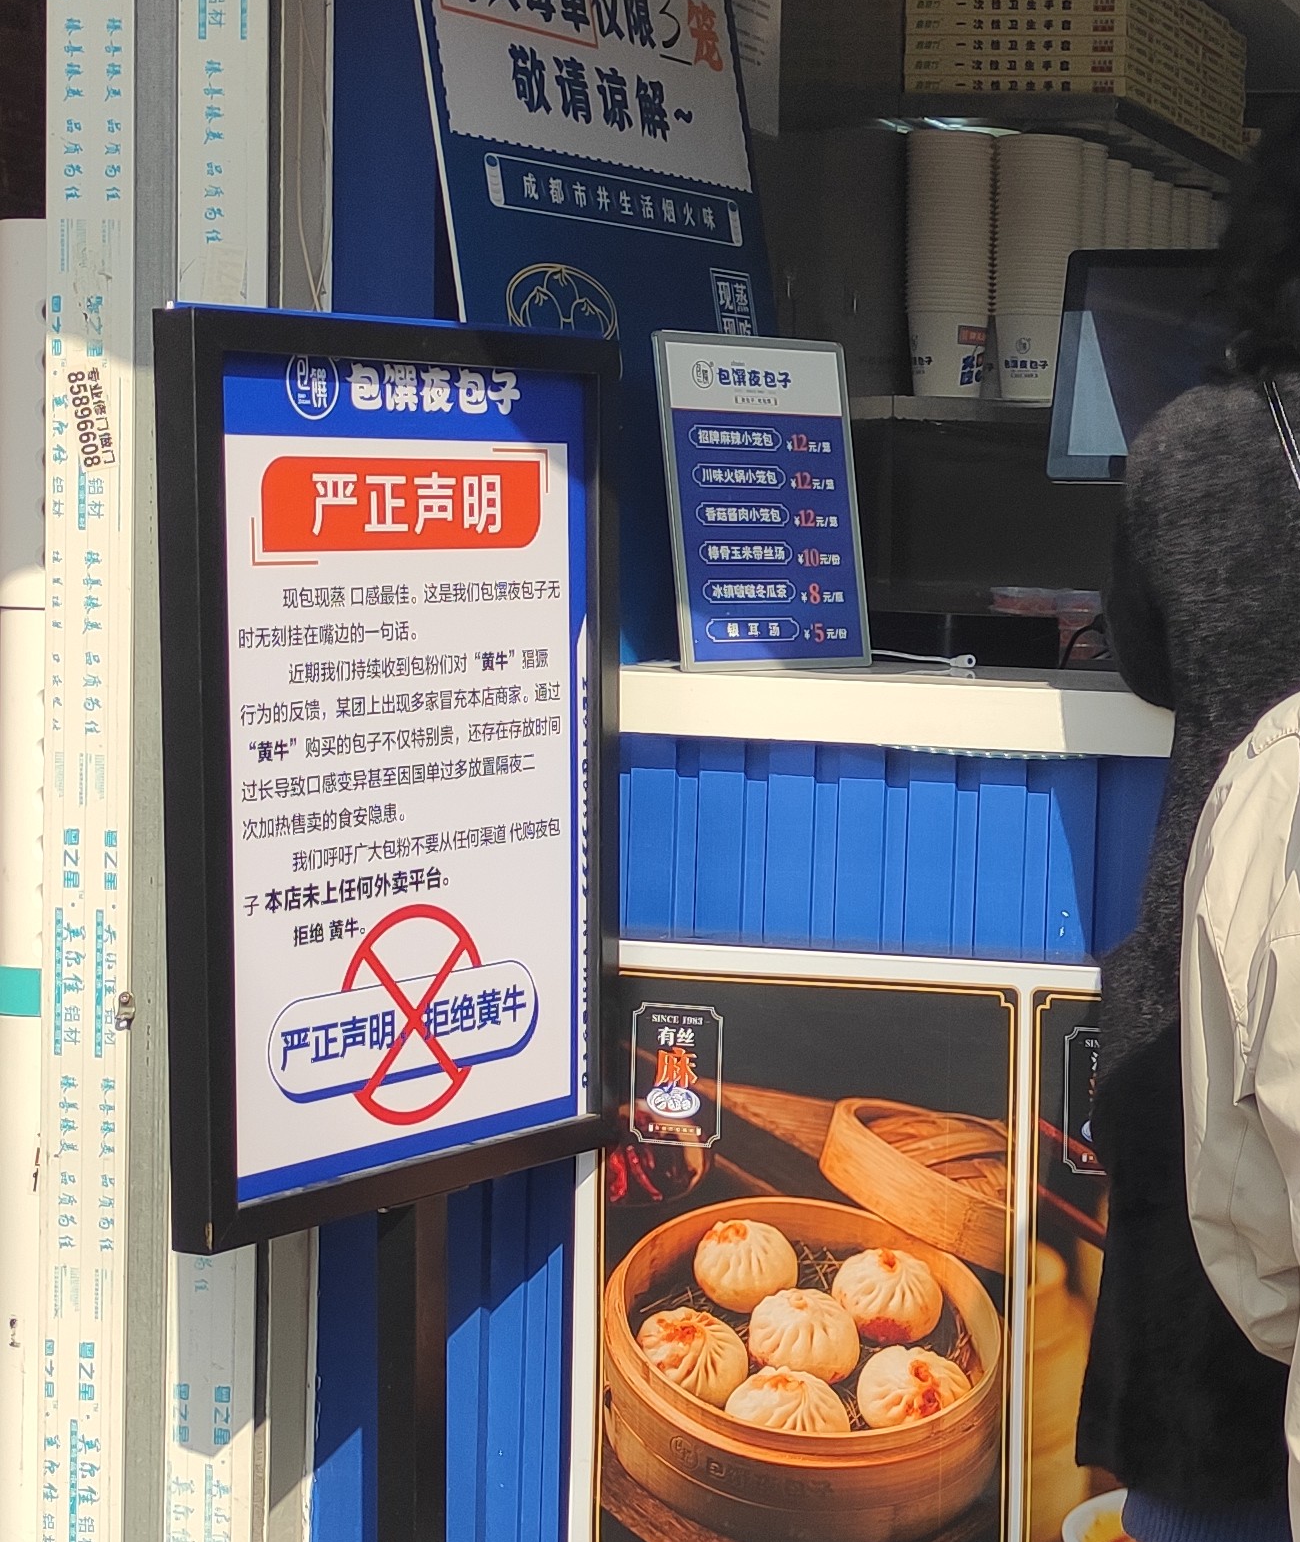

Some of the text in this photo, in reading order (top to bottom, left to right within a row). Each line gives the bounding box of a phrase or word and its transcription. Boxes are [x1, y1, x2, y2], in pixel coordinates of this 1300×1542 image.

[716, 367, 792, 388] 包馔夜包子
[346, 362, 521, 416] 包馔夜包子
[67, 371, 102, 468] 85896608
[698, 429, 774, 447] 招牌麻辣小笼包
[702, 468, 778, 485] 川味火锅小笼包
[311, 471, 503, 536] 严正声明
[238, 621, 418, 649] 时无刻挂在嘴边的一句话。
[727, 622, 781, 637] 银耳汤
[651, 1013, 704, 1026] SINCE 1983
[657, 1026, 695, 1047] 有丝
[654, 1047, 698, 1089] 麻
